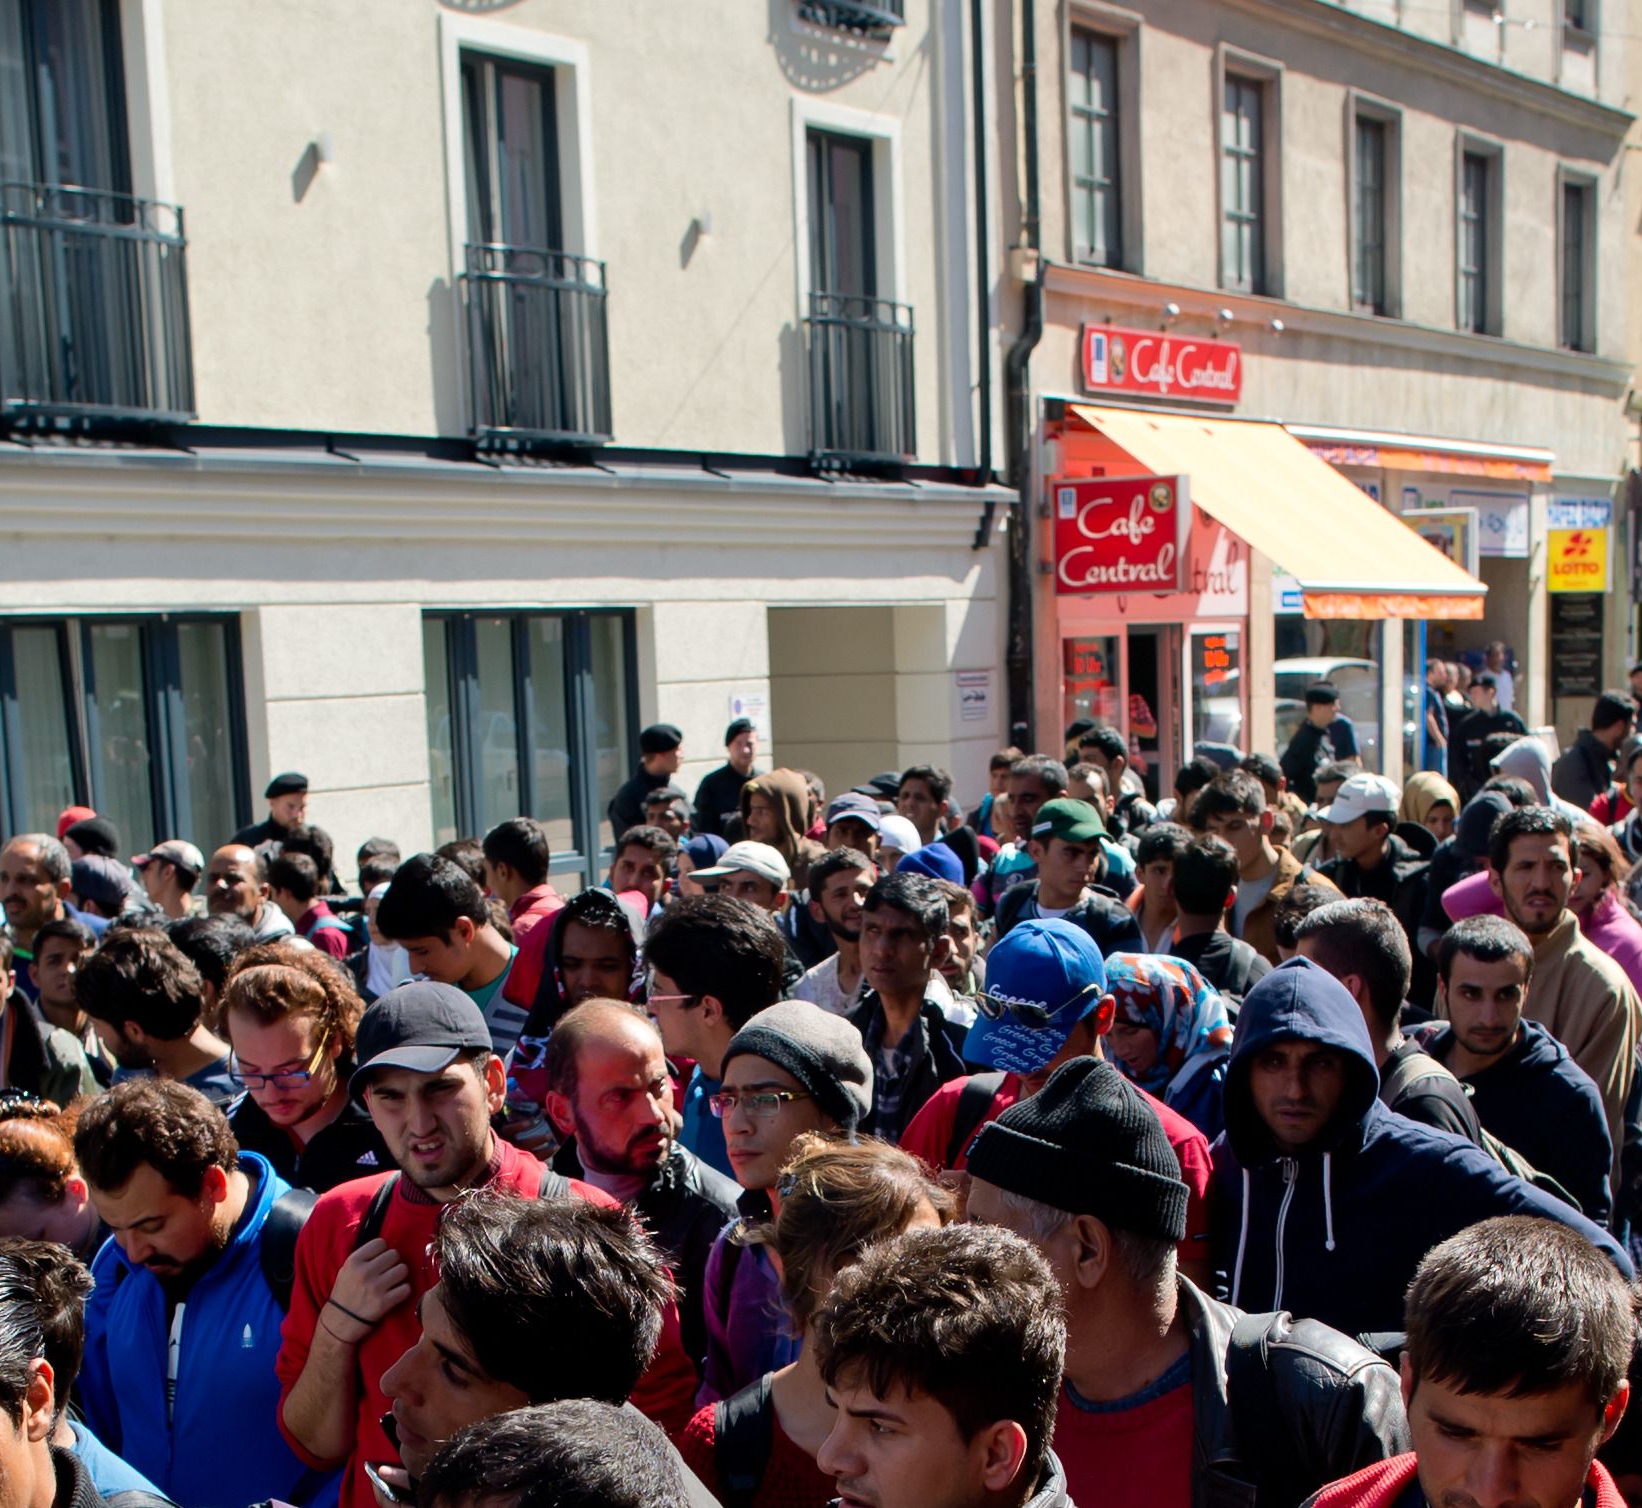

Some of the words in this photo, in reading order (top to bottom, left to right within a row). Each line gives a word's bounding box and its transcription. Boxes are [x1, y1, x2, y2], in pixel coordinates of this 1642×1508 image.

[1077, 493, 1156, 545] Cafe
[1058, 542, 1175, 587] Central
[1552, 561, 1599, 575] LOTTO
